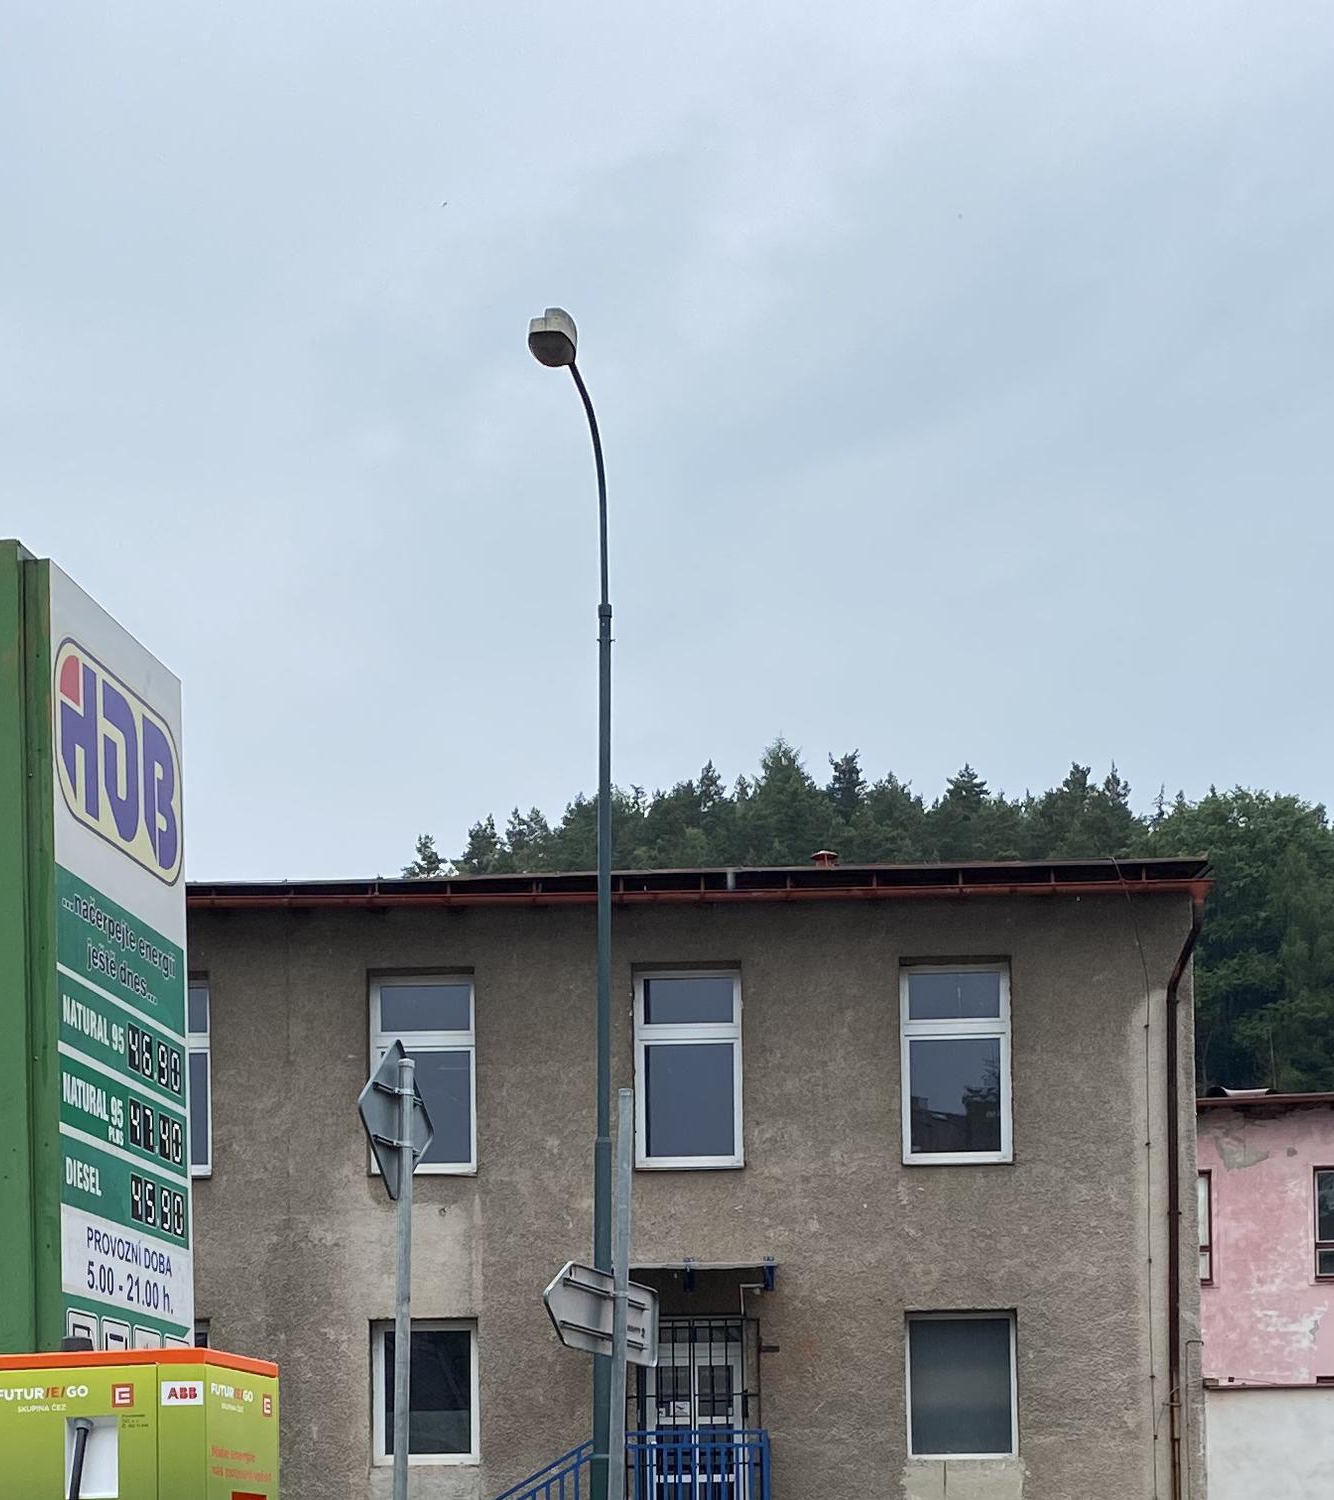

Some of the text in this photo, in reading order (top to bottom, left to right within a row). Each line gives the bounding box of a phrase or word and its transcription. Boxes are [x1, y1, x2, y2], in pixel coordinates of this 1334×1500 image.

[86, 937, 118, 980] ještě
[62, 994, 110, 1047] NATURAL
[111, 1023, 124, 1054] 95
[62, 1072, 109, 1122] NATURAL
[110, 1096, 124, 1129] 95
[108, 1125, 124, 1147] PLUS
[65, 1157, 102, 1197] DIESEL
[87, 1227, 172, 1278] PROVOZNÍ DOBA
[87, 1260, 114, 1296] 5.00
[127, 1273, 159, 1310] 21.00
[163, 1285, 174, 1315] h.
[168, 1387, 197, 1399] ABB
